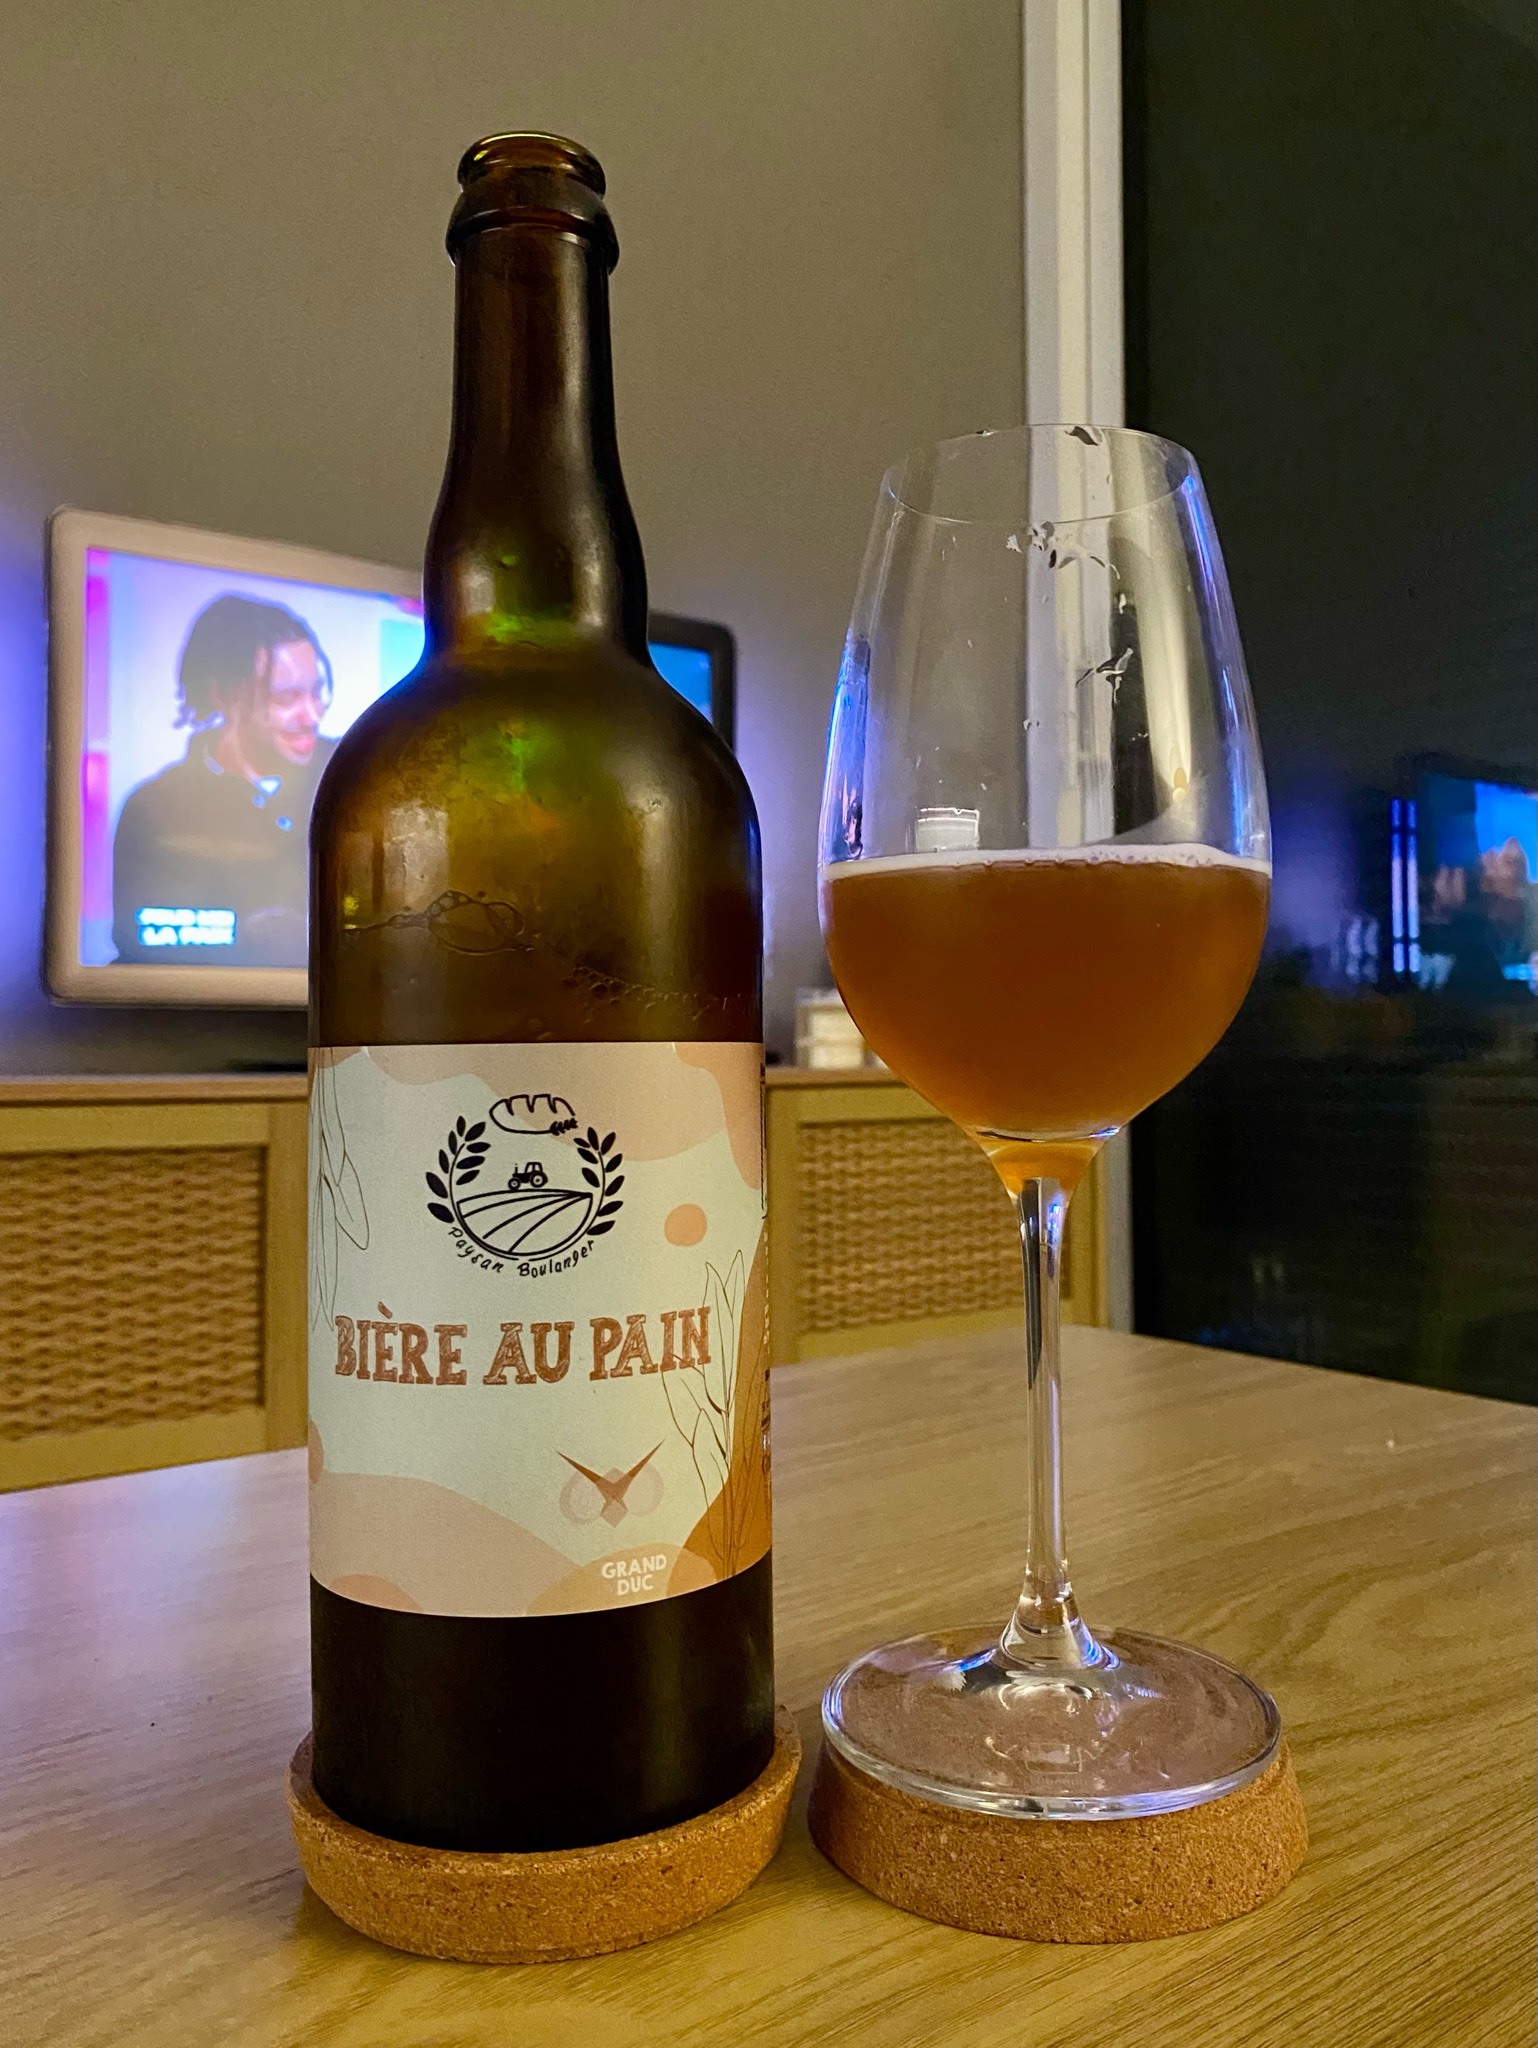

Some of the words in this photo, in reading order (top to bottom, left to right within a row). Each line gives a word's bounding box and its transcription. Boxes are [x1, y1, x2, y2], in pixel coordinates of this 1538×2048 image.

[448, 1226, 505, 1273] Paysan
[516, 1239, 595, 1279] Boulanger
[334, 1301, 468, 1386] BIÈRE
[482, 1321, 576, 1386] AU
[588, 1306, 712, 1382] PAIN
[601, 1553, 667, 1579] GRAND
[617, 1573, 654, 1597] DUC
